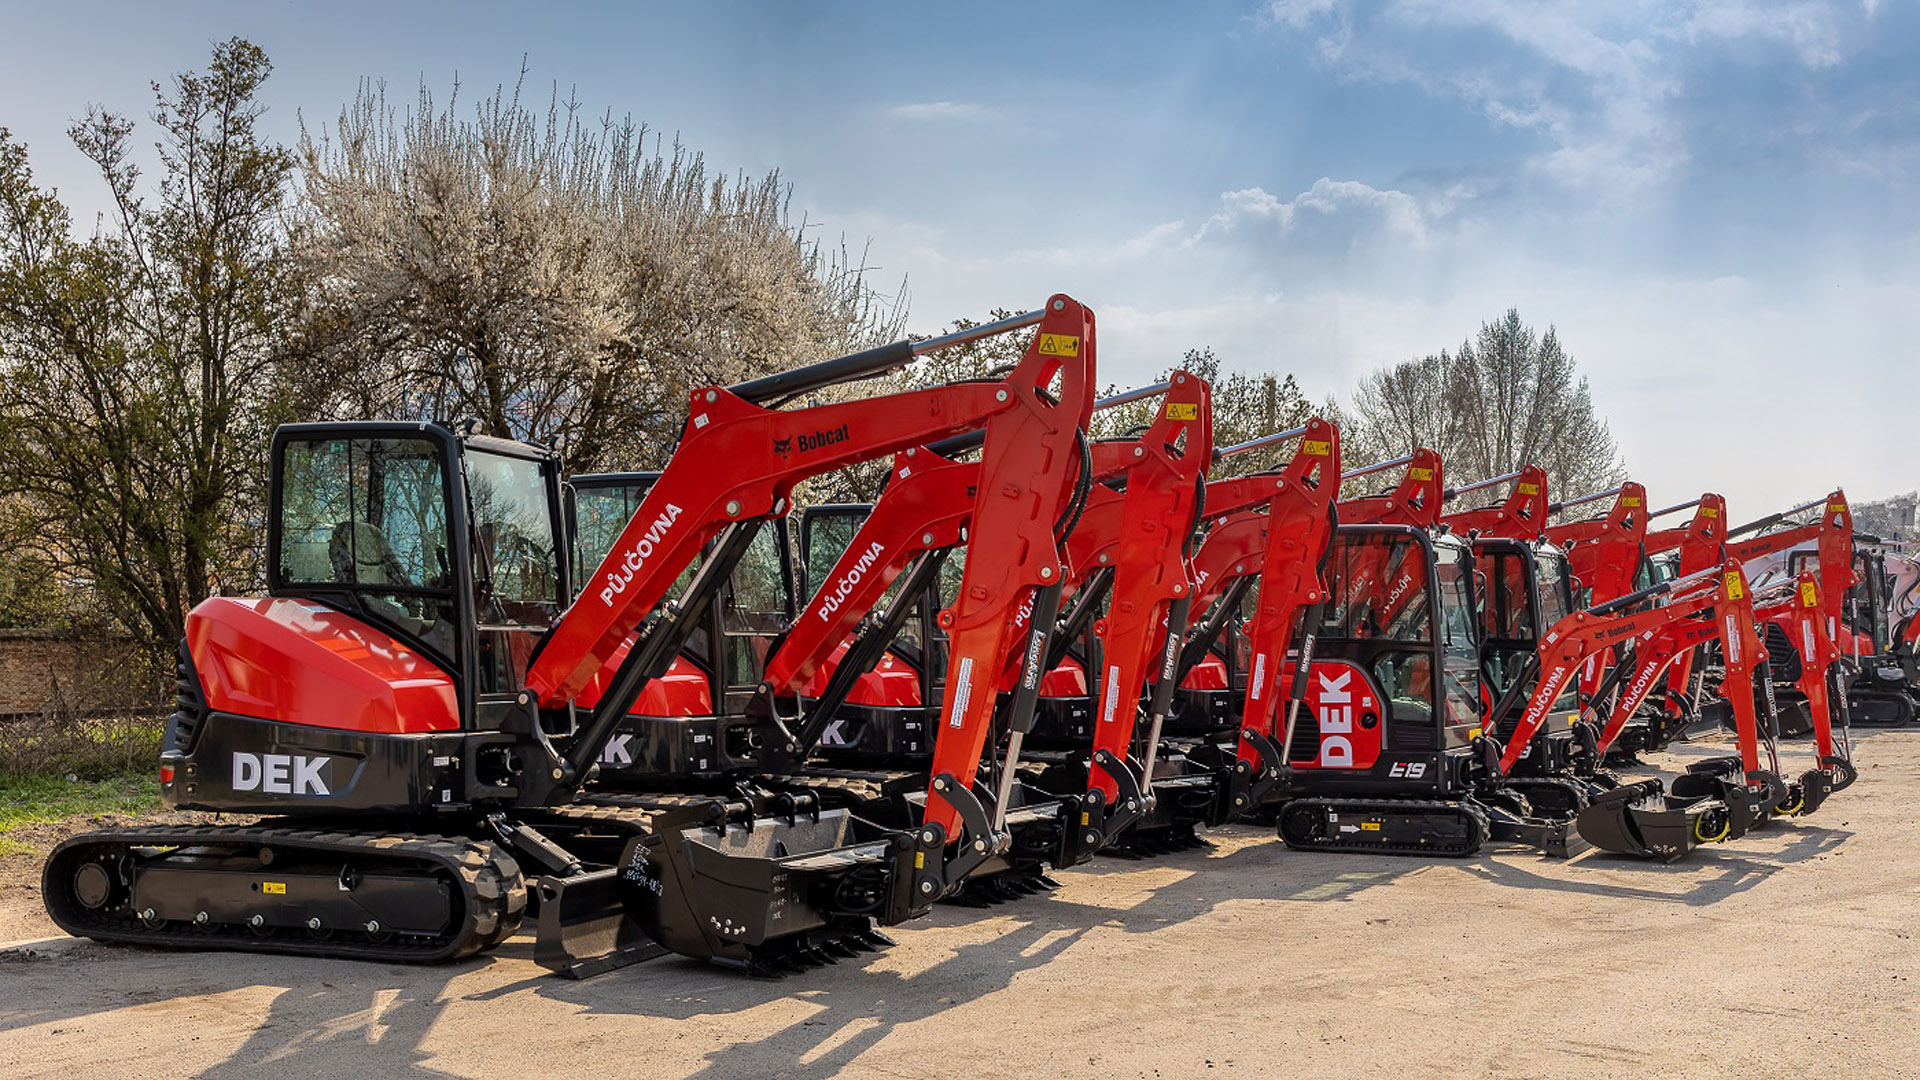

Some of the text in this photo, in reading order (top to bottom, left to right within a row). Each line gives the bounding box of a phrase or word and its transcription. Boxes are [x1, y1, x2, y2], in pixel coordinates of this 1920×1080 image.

[798, 424, 850, 453] Bobcat
[600, 502, 683, 607] PŮJČOVNA
[818, 541, 885, 622] PŮJČOVNA
[1526, 665, 1566, 726] PŮJČOVNA
[1621, 660, 1659, 712] PŮJČOVNA
[1319, 670, 1354, 768] DEK
[232, 751, 331, 796] DEK
[1388, 761, 1427, 779] E19
